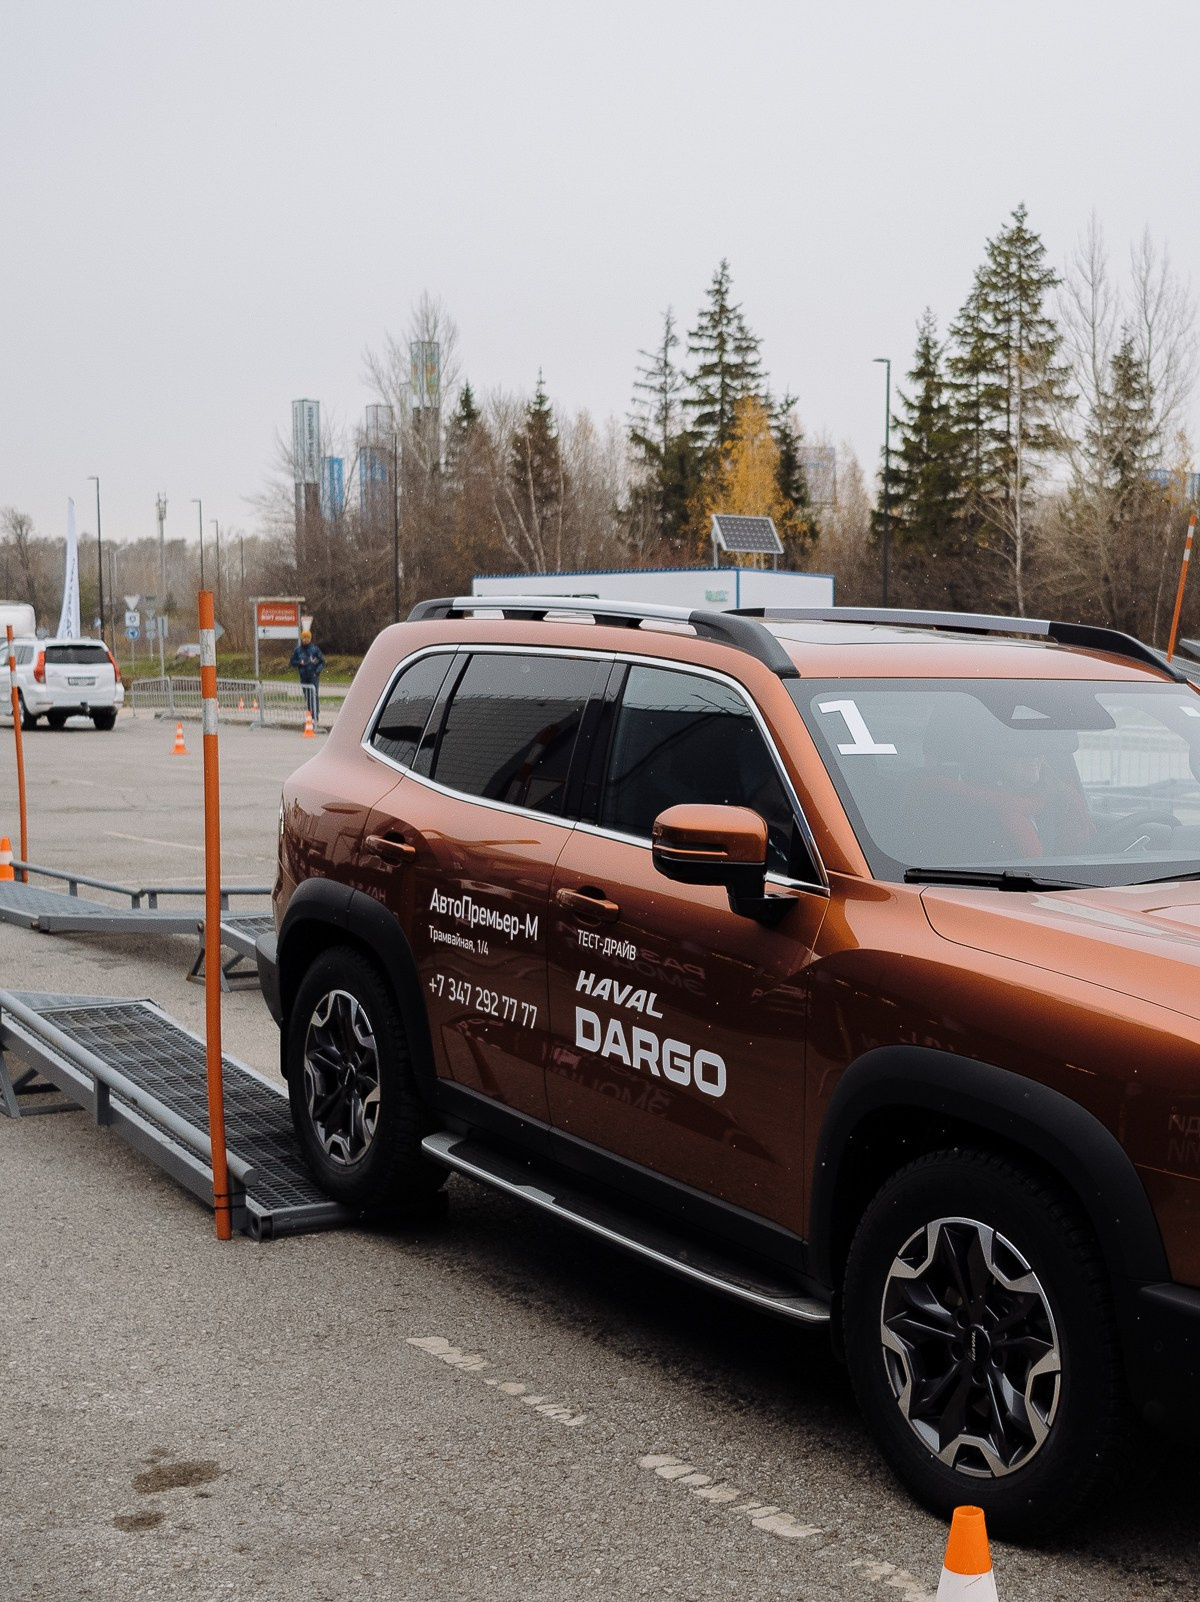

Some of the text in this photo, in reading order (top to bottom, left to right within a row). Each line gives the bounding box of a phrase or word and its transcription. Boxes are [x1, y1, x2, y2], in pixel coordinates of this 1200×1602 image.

[818, 699, 898, 756] 1
[428, 925, 489, 956] Трамвайная, 1/4
[429, 888, 539, 942] АвтоПремьер-М
[577, 929, 637, 961] ТЕСТ-ДРАЙВ
[429, 973, 538, 1030] +7 347 292 77 77
[575, 970, 664, 1020] HAVAL
[575, 1005, 727, 1098] DARGO
